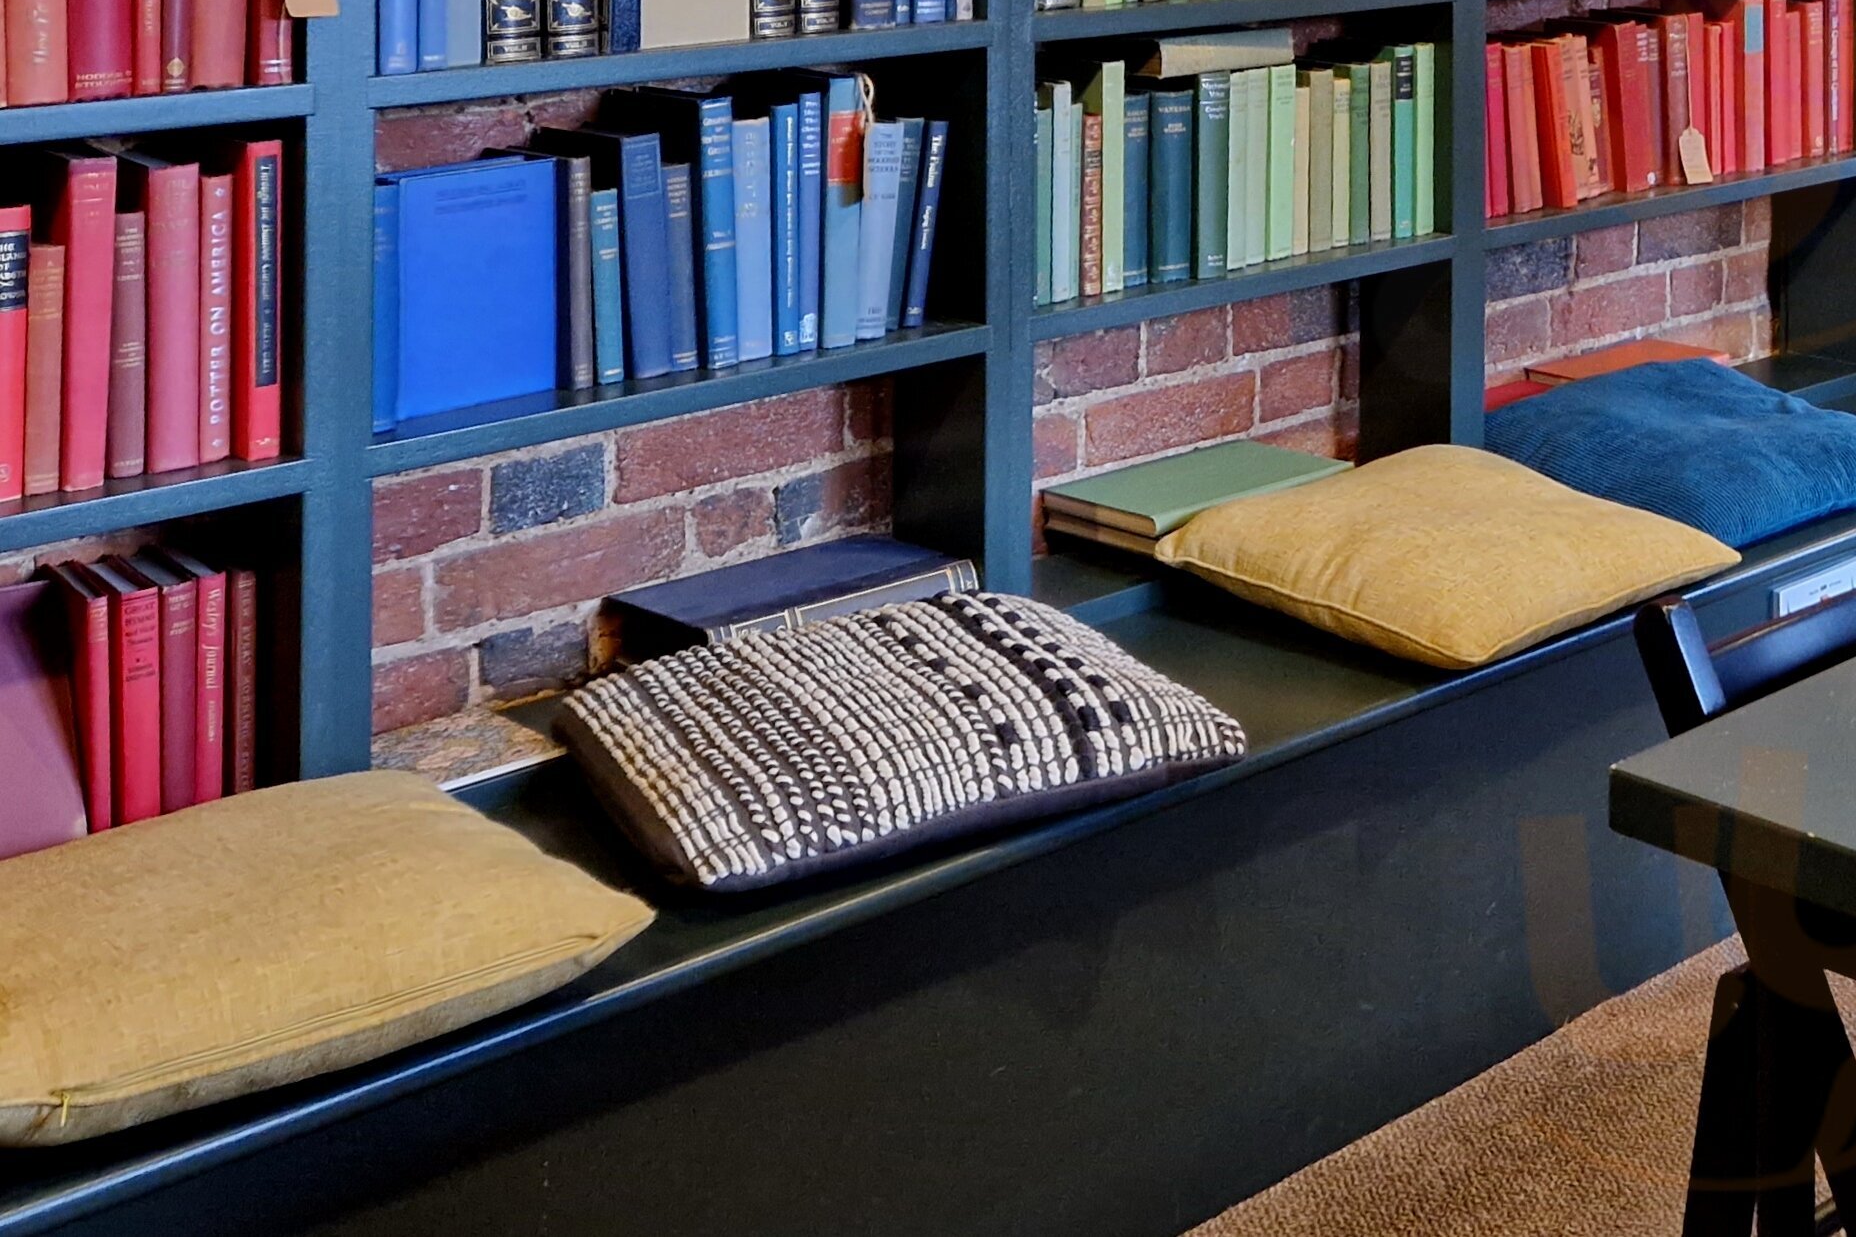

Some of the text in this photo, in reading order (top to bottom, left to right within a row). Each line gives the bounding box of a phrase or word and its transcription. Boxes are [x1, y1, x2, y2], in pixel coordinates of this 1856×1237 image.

[1159, 105, 1191, 114] VANESSA
[929, 134, 943, 155] The
[258, 163, 272, 205] Through
[210, 211, 226, 425] POTTER ON AMERICA
[124, 602, 155, 616] GREAT
[202, 588, 221, 690] Wesley's Journal
